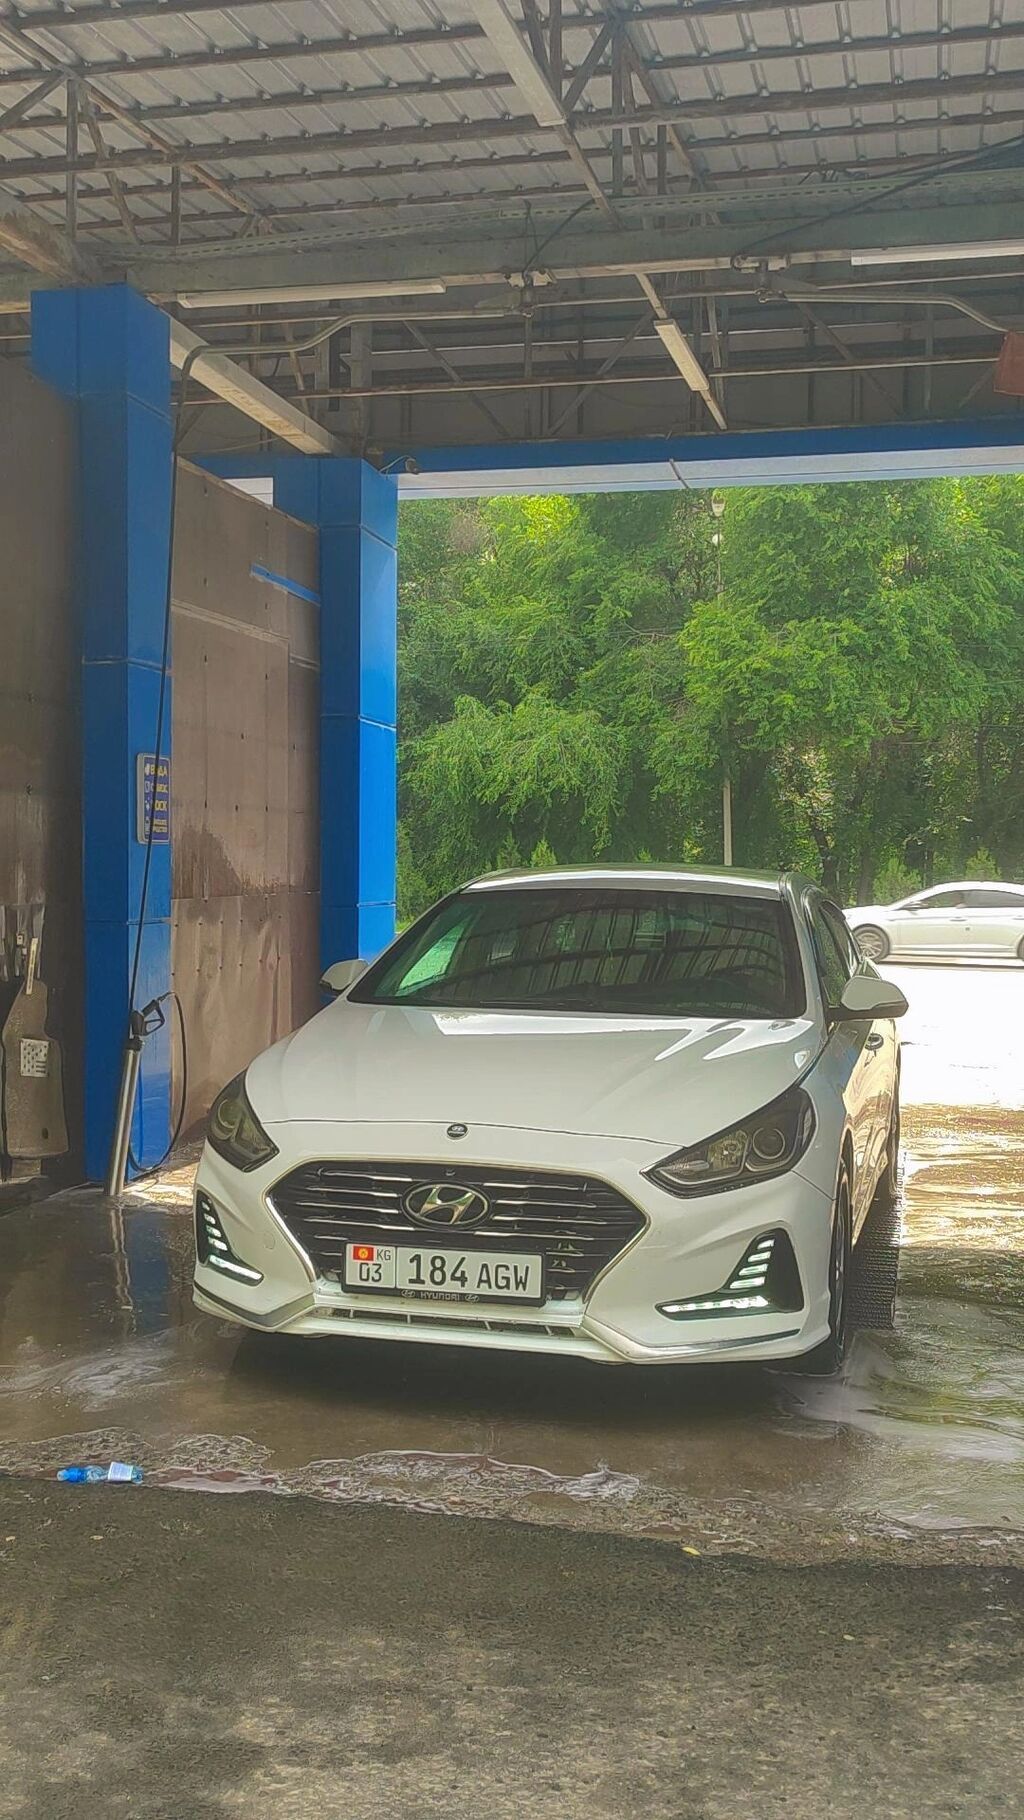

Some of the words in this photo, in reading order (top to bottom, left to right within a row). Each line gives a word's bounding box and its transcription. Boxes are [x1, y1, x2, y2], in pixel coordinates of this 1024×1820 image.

[376, 1249, 391, 1261] KG
[358, 1262, 382, 1283] 03
[408, 1253, 468, 1288] 184
[476, 1263, 530, 1292] AGW
[420, 1290, 460, 1302] HYUNDAI
